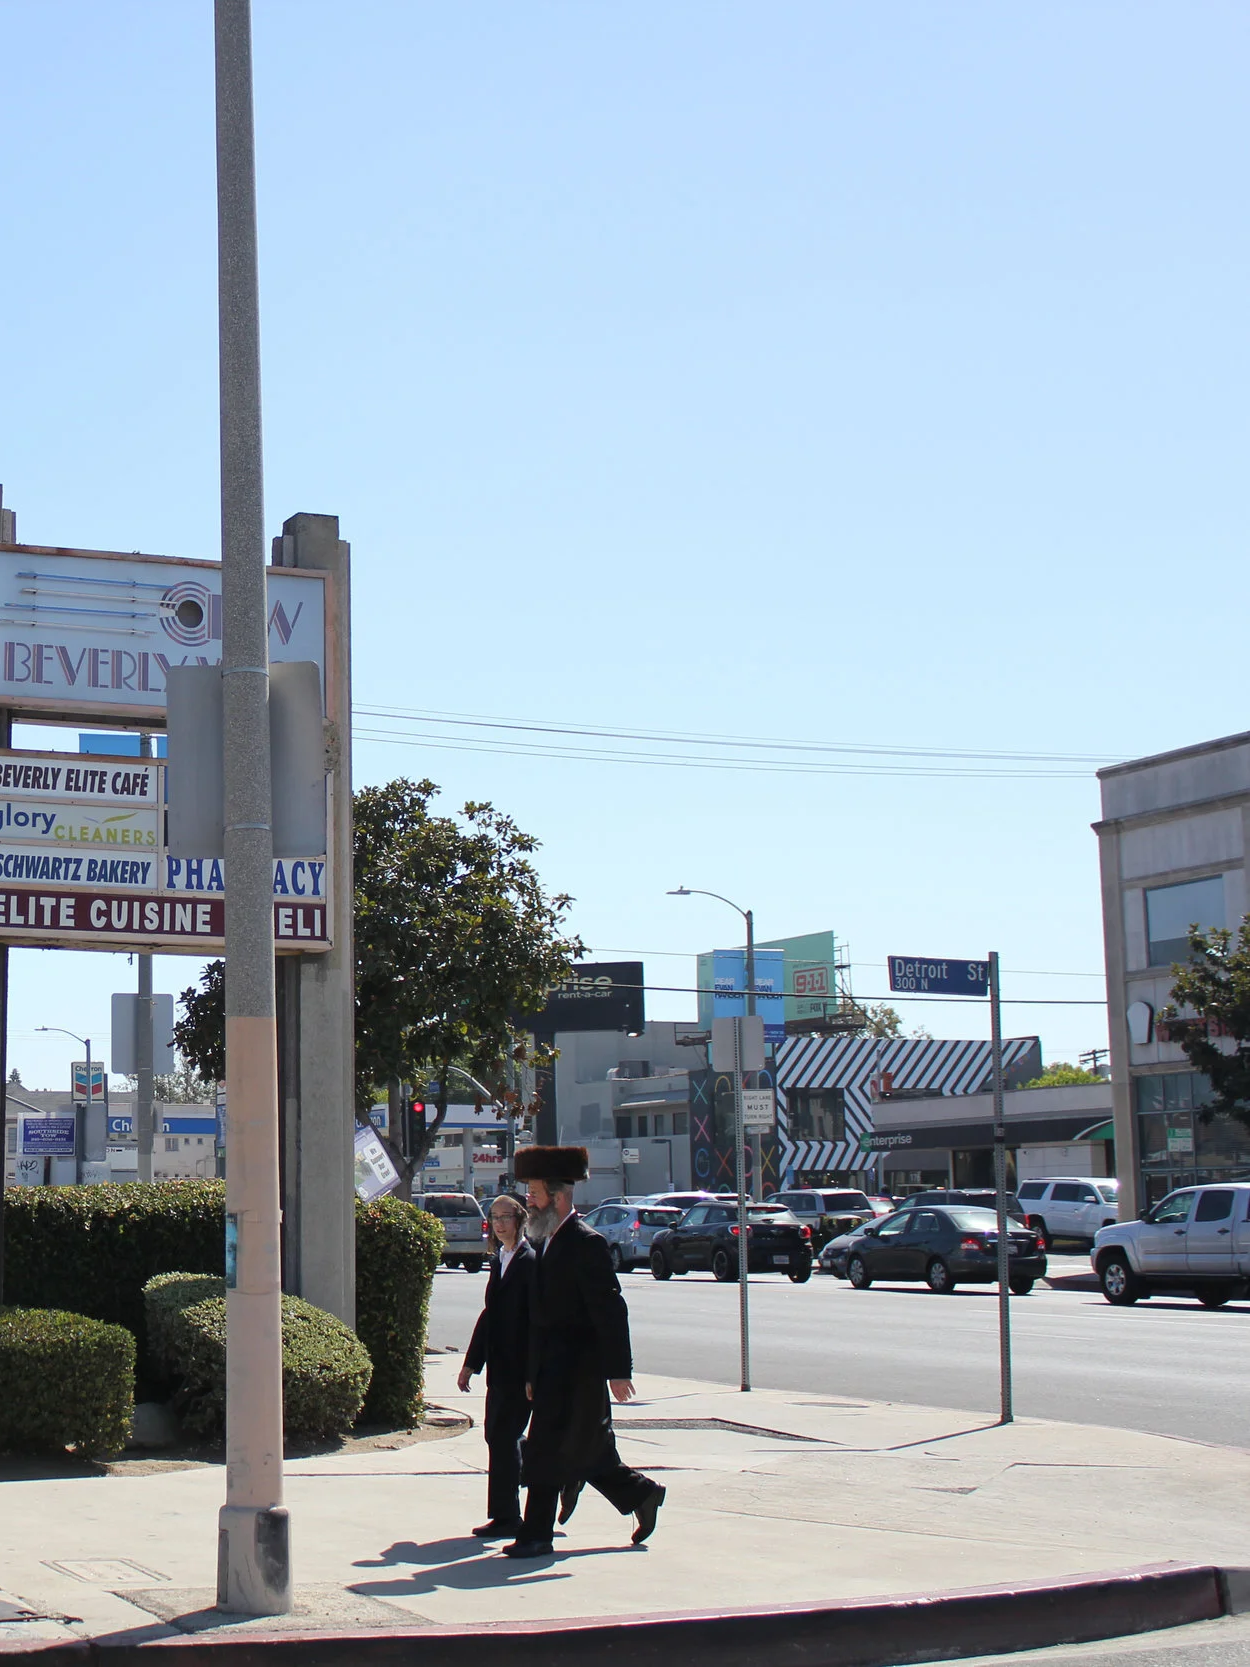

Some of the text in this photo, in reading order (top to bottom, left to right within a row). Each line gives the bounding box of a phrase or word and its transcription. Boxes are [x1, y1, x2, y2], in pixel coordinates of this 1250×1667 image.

[65, 768, 107, 794] ELITE
[111, 766, 148, 796] CAFÉ
[54, 824, 156, 846] CLEANERS
[87, 857, 151, 885] BAKERY
[166, 857, 325, 896] PHAACY
[90, 899, 212, 932] CUISINE
[279, 908, 322, 936] ELI
[895, 959, 985, 981] Detroit St
[558, 990, 613, 999] rent-a-car
[895, 977, 928, 990] 300 N
[865, 1133, 912, 1147] enterprise
[473, 1153, 503, 1163] 24hrs
